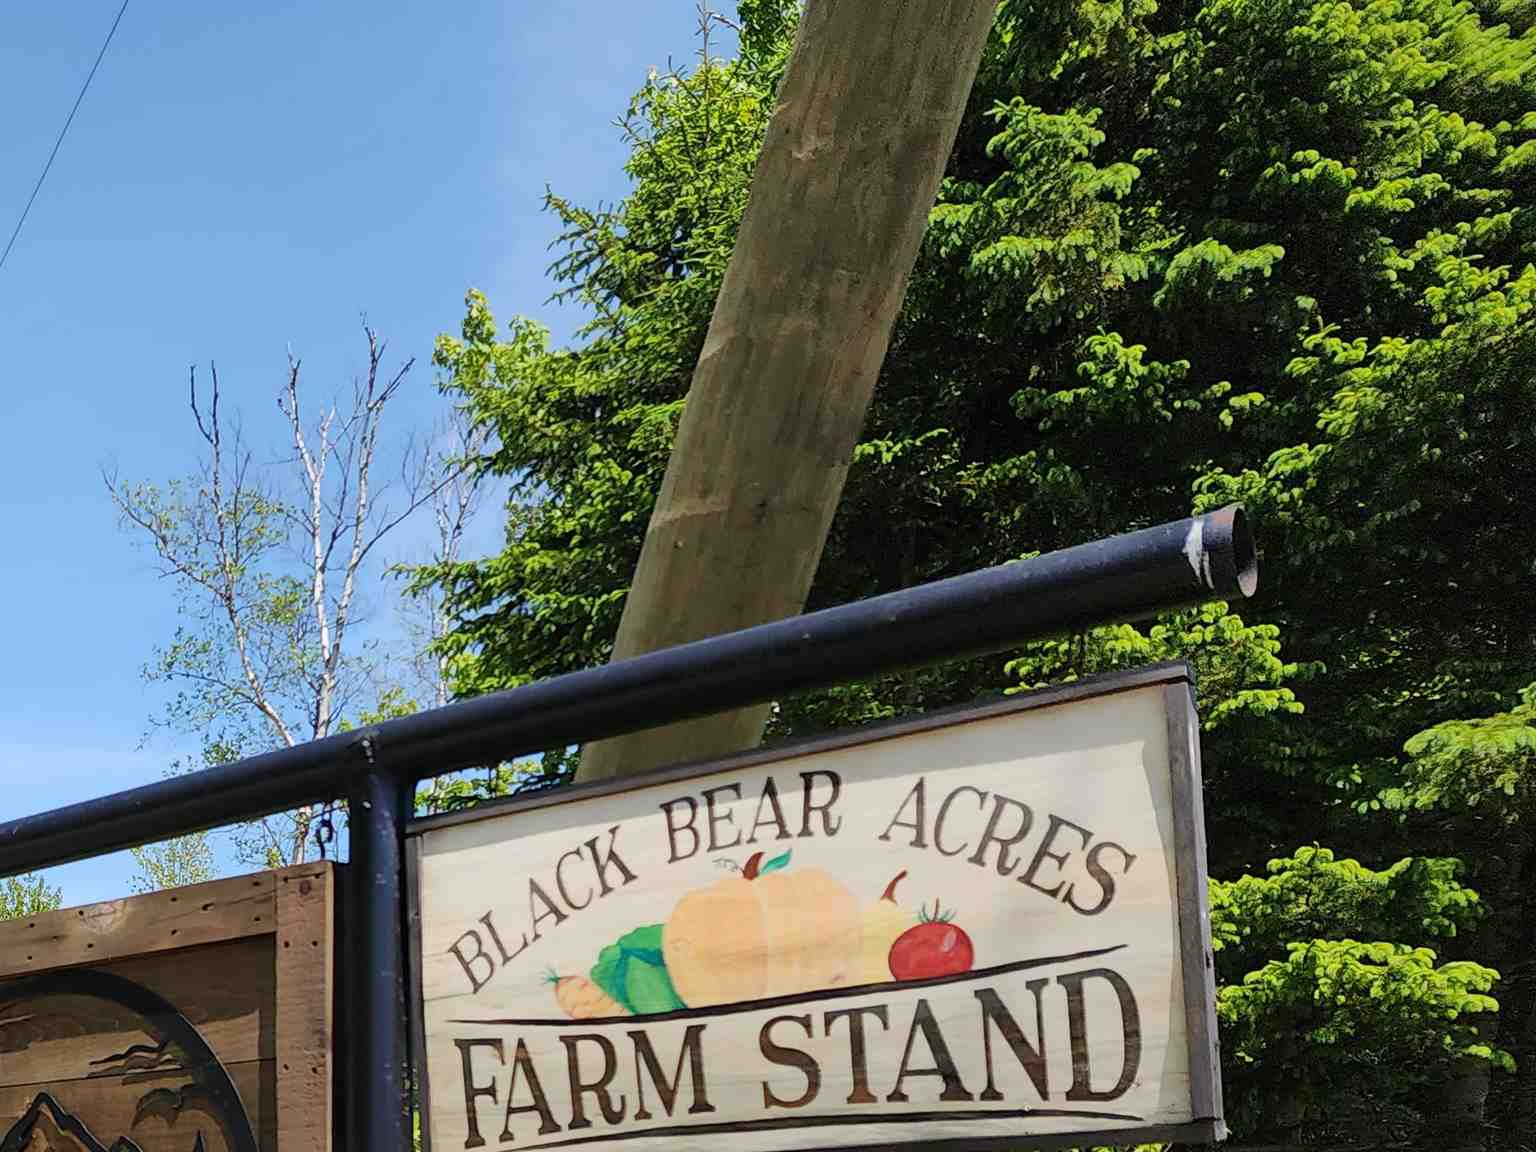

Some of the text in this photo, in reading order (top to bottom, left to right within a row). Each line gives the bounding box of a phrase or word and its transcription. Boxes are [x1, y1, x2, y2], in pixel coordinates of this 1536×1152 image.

[447, 770, 1135, 994] BLACK BEAR ACRES
[455, 967, 1142, 1149] FARM STAND
